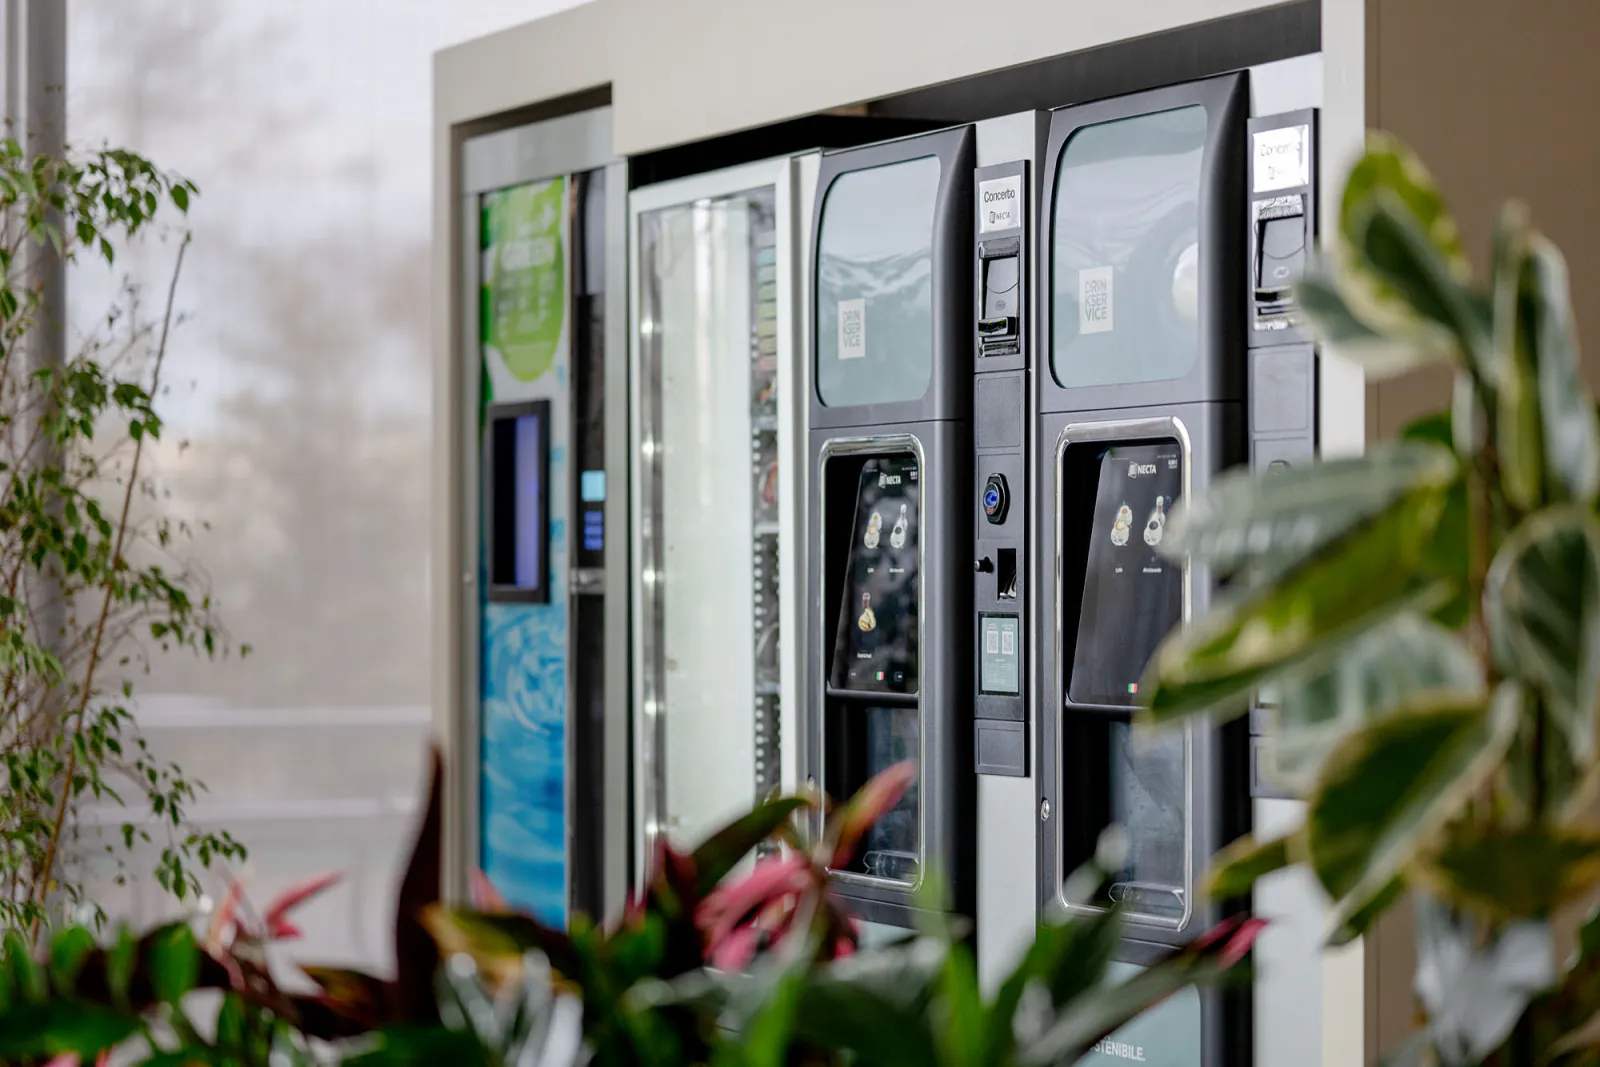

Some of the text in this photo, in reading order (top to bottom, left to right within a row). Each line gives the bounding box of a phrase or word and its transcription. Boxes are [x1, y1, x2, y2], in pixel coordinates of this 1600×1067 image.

[984, 188, 1016, 203] Concerto
[996, 212, 1011, 220] NECTA
[1085, 278, 1107, 294] DRIN
[1085, 306, 1107, 321] VICE
[1137, 464, 1157, 475] NECTA
[886, 475, 902, 485] NECTA
